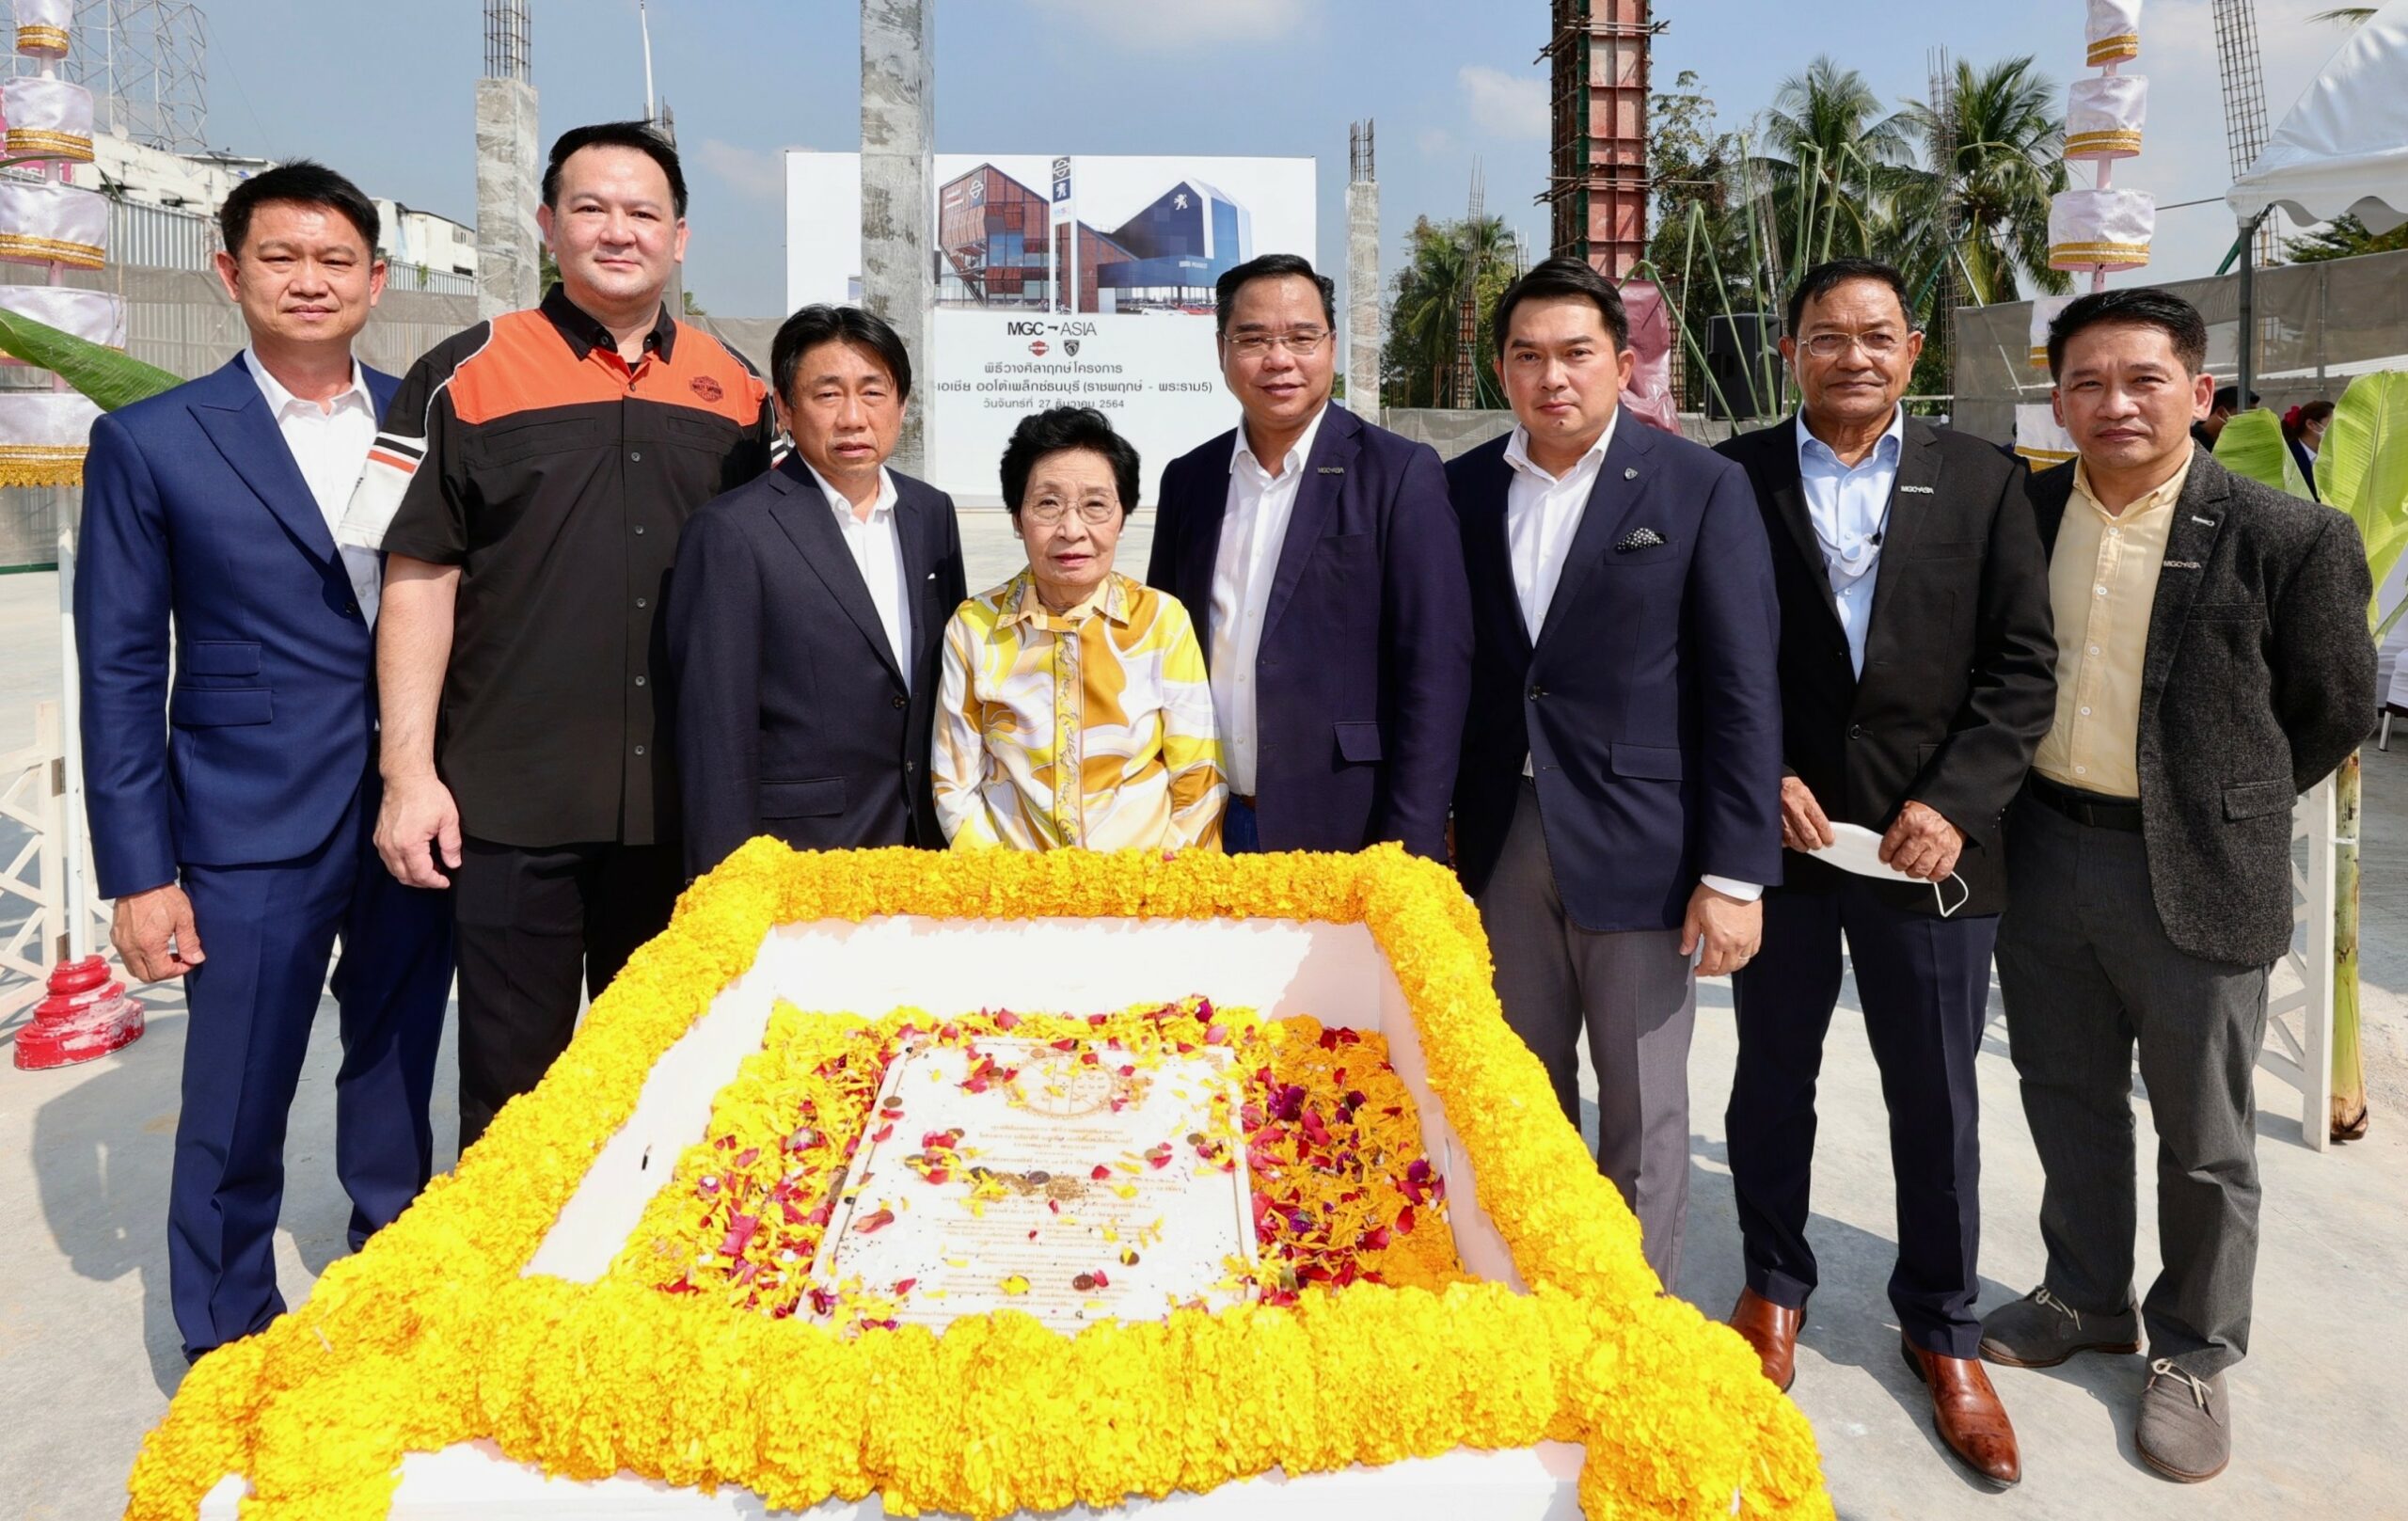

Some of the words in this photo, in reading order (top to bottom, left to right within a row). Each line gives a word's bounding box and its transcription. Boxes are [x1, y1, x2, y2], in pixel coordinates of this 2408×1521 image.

[1007, 322, 1044, 336] MGC
[1060, 322, 1098, 336] ASIA
[936, 380, 972, 391] เอเชีย
[1083, 379, 1143, 393] (ราชพฤกษ์
[1158, 382, 1212, 394] พระราม5)
[1038, 399, 1051, 408] 27
[1099, 400, 1124, 408] 2564
